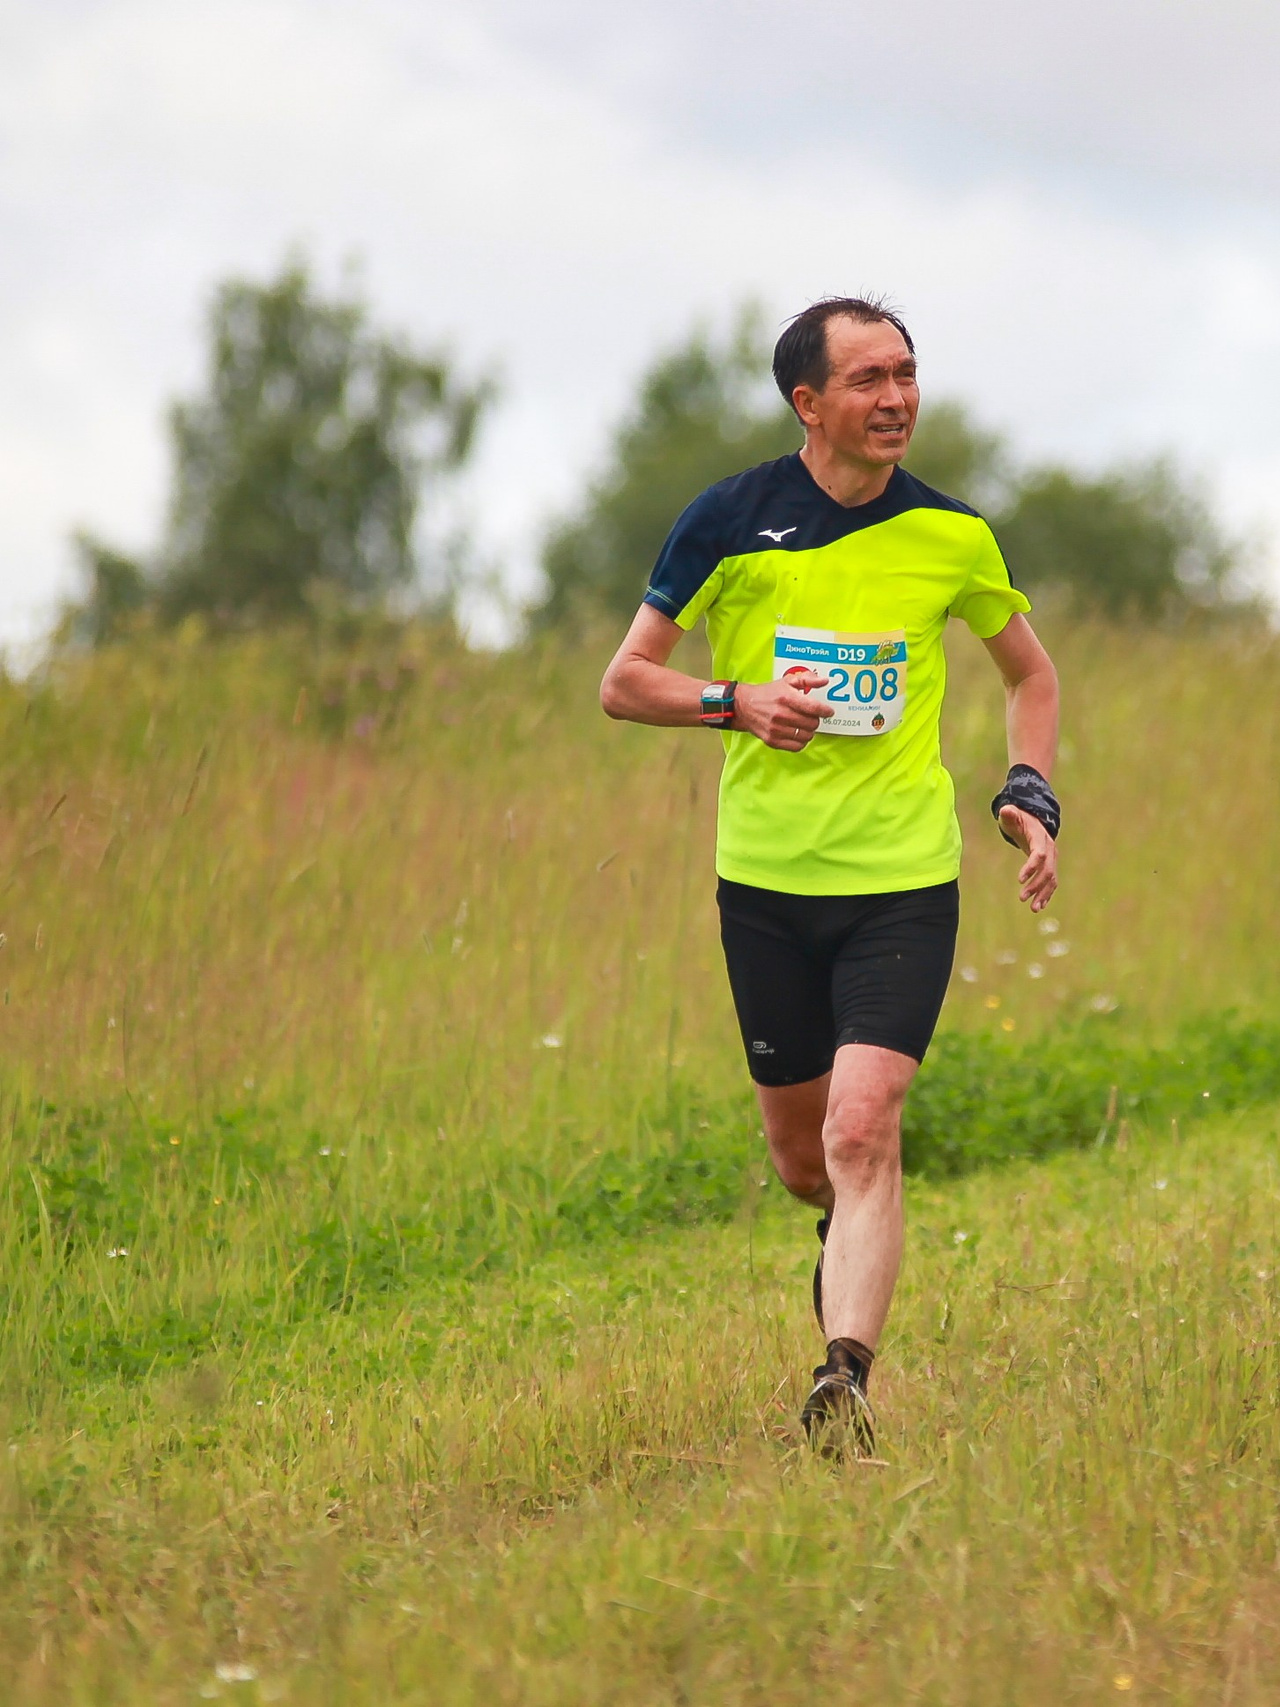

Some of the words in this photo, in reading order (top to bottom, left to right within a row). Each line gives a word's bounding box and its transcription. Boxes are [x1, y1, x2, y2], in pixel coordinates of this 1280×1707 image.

[837, 648, 866, 661] D19
[826, 667, 898, 703] 208
[822, 717, 861, 727] 06.07.2024
